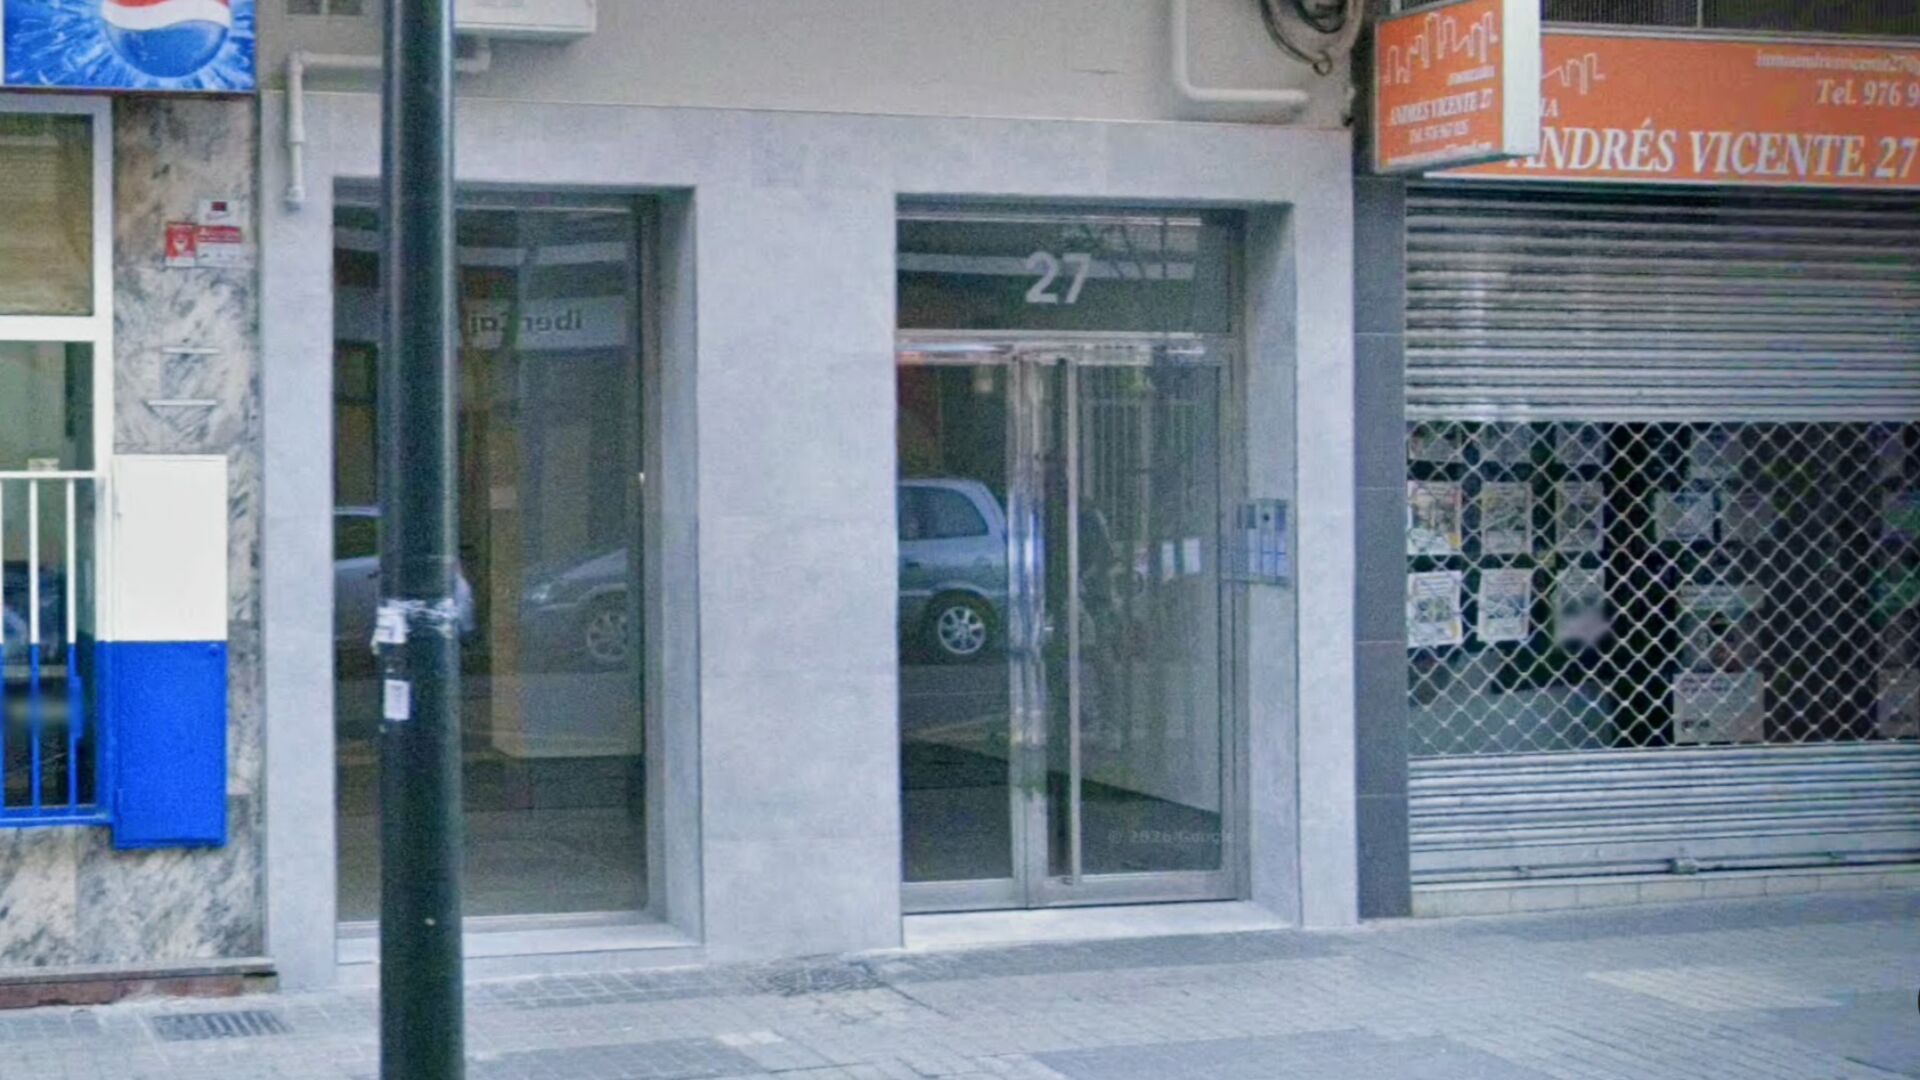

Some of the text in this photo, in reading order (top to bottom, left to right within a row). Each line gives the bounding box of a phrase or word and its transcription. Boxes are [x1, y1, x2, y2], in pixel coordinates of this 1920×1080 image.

[1816, 78, 1857, 106] Tel.
[1864, 79, 1901, 106] 976
[1688, 130, 1866, 178] VICENTE
[1874, 135, 1920, 179] 27
[1025, 251, 1091, 304] 27
